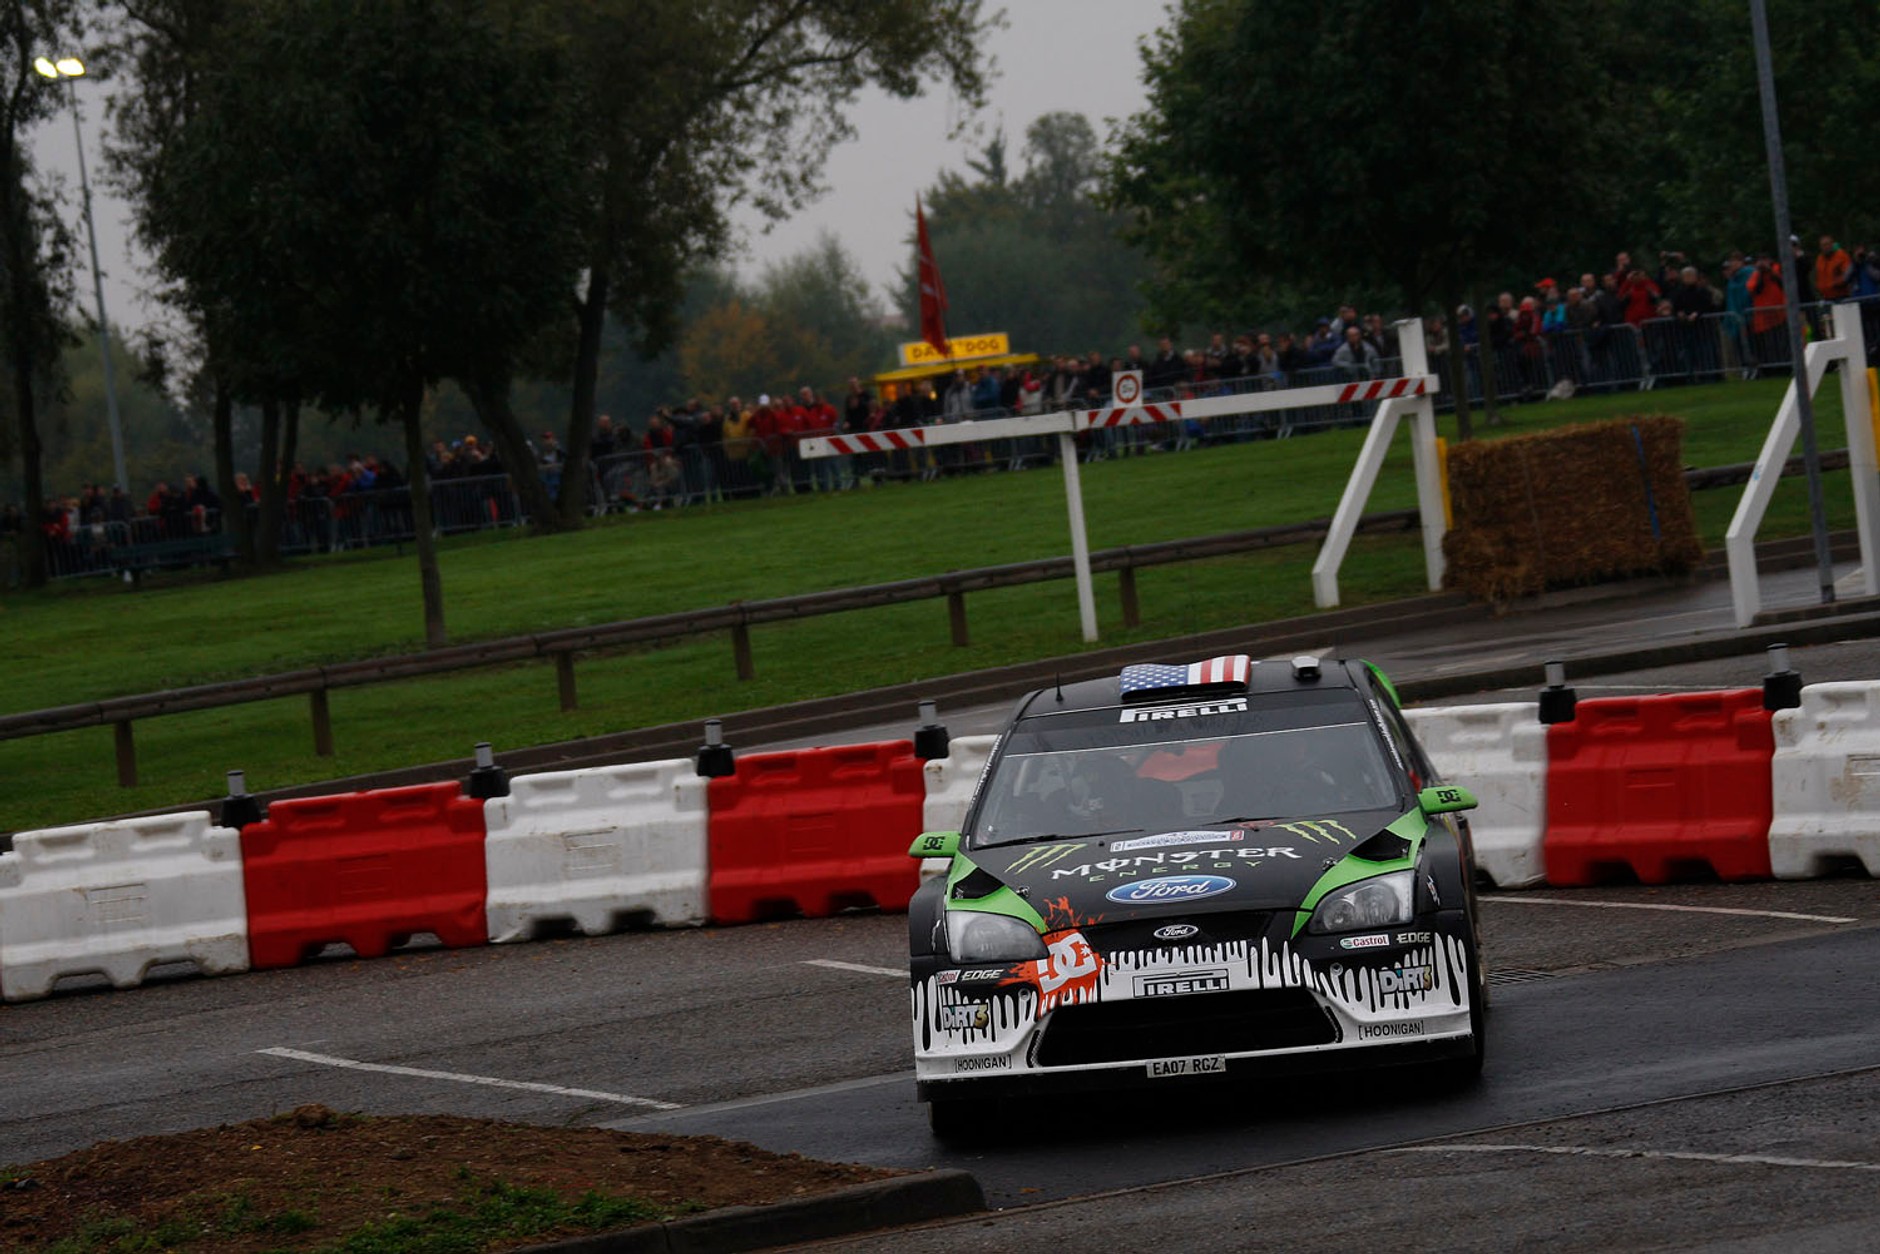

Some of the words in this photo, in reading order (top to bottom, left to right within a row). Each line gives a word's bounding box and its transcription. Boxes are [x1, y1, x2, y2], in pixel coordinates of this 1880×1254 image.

[966, 339, 999, 352] DOG
[1119, 698, 1248, 723] PIRELLI
[1051, 846, 1302, 881] MONSTER
[1088, 860, 1262, 883] ENERGY
[1130, 878, 1212, 900] Ford
[1163, 926, 1189, 938] Ford
[1352, 936, 1388, 947] Castrol
[1396, 932, 1432, 944] EDGE
[961, 969, 1004, 981] EDGE
[1133, 969, 1230, 998] PIRELLI
[1153, 1060, 1186, 1075] EA07
[1193, 1057, 1220, 1071] RGZ
